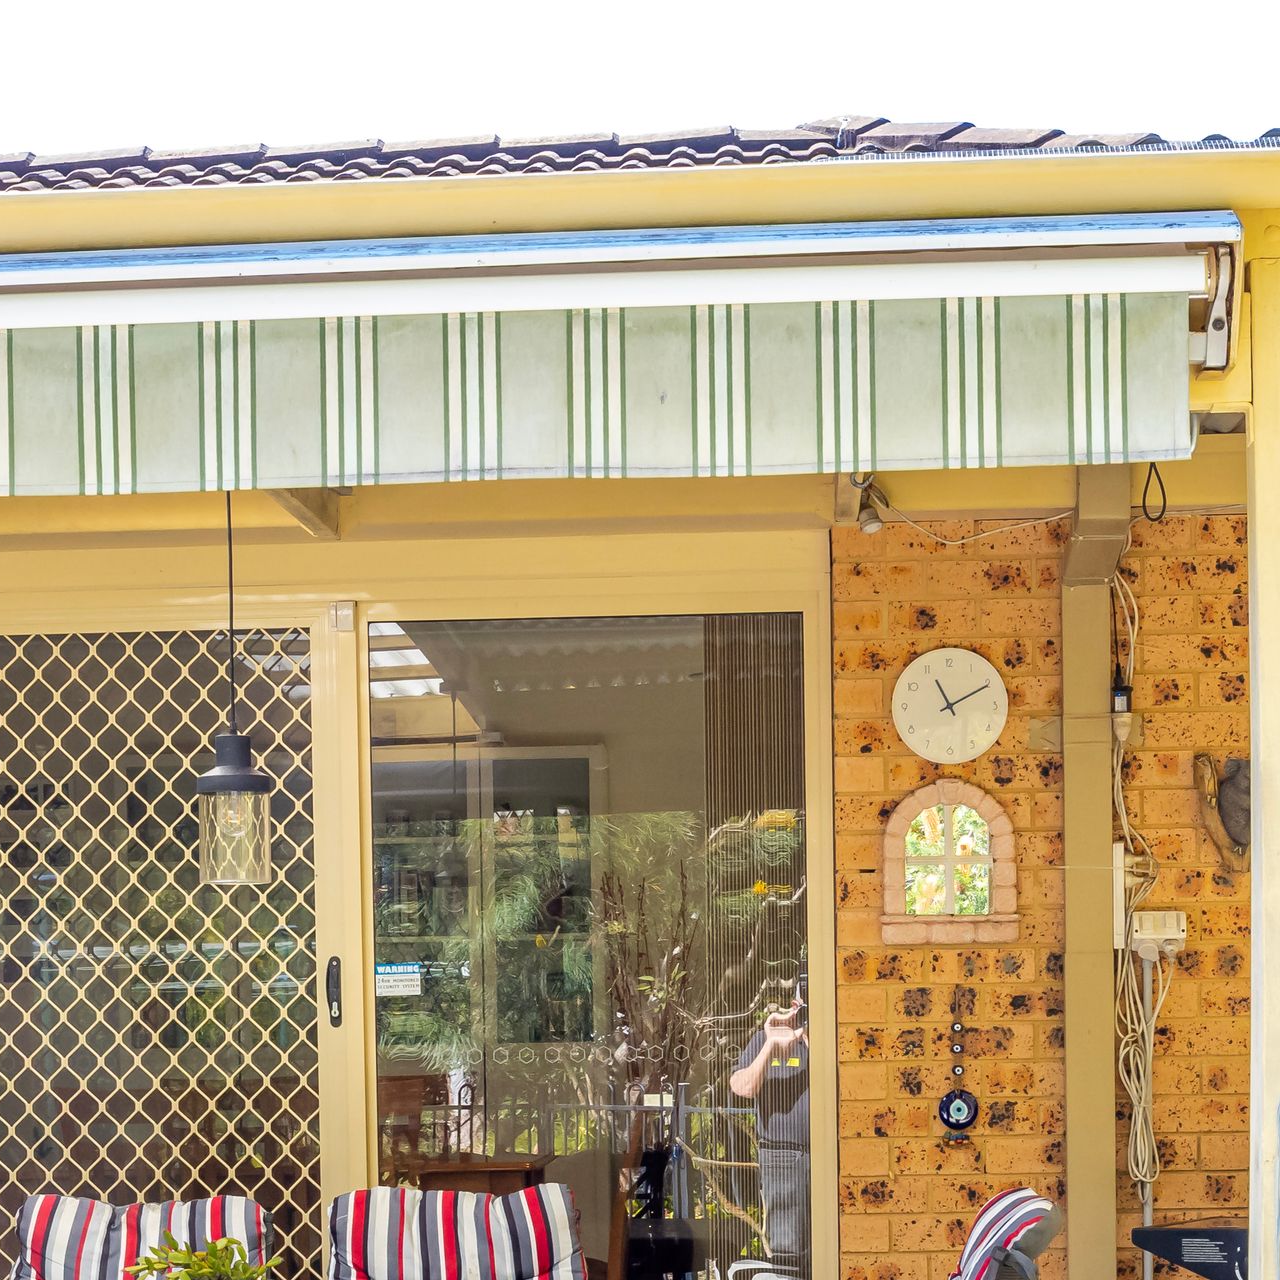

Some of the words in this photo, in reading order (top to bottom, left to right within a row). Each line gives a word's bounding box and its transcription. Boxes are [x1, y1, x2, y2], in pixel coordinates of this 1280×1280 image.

[945, 658, 953, 668] 12
[924, 665, 931, 674] 11
[907, 682, 919, 692] 10
[984, 678, 991, 689] 2
[901, 703, 908, 712] 9
[993, 701, 999, 711] 3
[908, 725, 915, 735] 8
[985, 723, 991, 732] 4
[970, 740, 976, 750] 5
[946, 746, 954, 756] 6
[377, 965, 419, 974] WARNING
